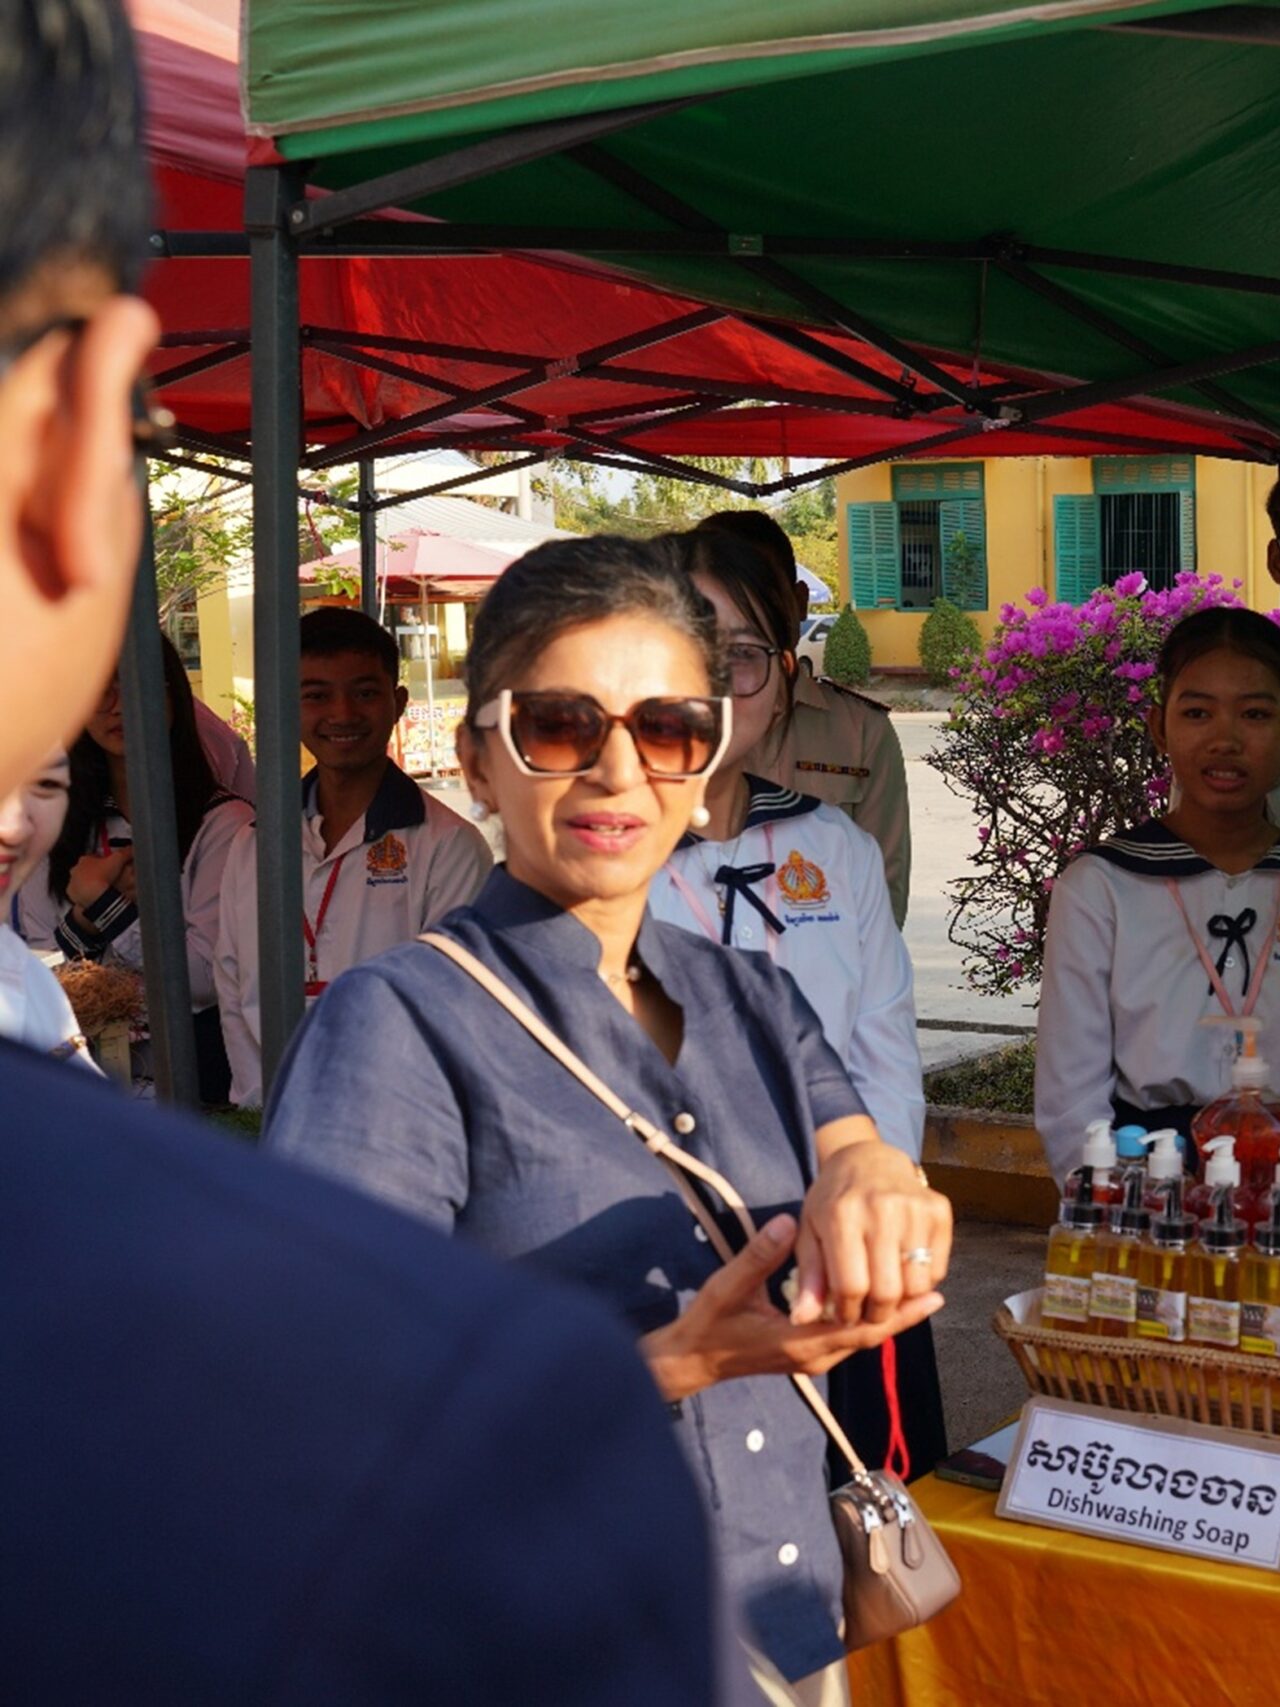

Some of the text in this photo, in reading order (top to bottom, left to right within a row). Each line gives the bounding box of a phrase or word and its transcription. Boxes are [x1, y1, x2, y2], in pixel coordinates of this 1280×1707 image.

[1026, 1439, 1278, 1516] សាប៊ូលាងចាន
[1047, 1487, 1250, 1553] Dishwashing Soap
